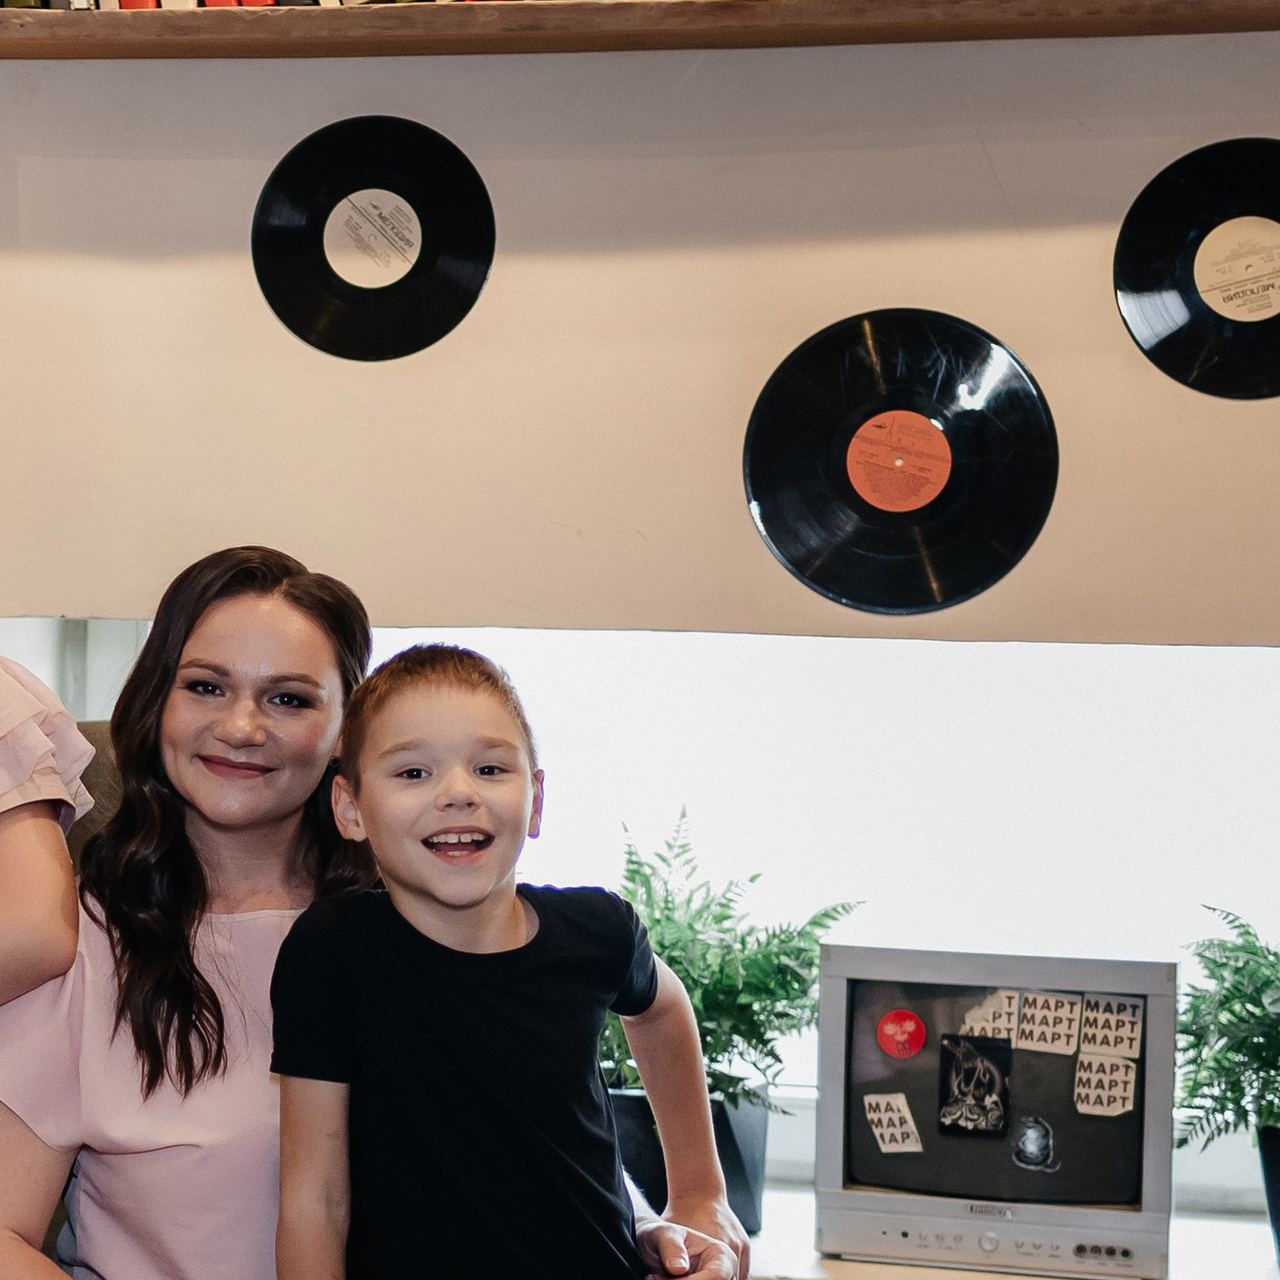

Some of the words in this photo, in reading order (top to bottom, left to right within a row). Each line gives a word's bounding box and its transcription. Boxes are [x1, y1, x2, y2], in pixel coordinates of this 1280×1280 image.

[375, 211, 416, 250] МЕЛОДИЯ
[1221, 282, 1276, 304] МЕЛОДИЯ
[1022, 996, 1078, 1015] МАРТ
[1084, 999, 1140, 1018] МАРТ
[1021, 1012, 1076, 1031] МАРТ
[1083, 1015, 1139, 1034] МАРТ
[1019, 1028, 1074, 1046] МАРТ
[1082, 1032, 1137, 1050] МАРТ
[1077, 1060, 1133, 1078] МАРТ
[1076, 1076, 1131, 1094] МАРТ
[867, 1101, 902, 1115] МА
[1075, 1092, 1130, 1110] МАРТ
[871, 1118, 908, 1131] МАР
